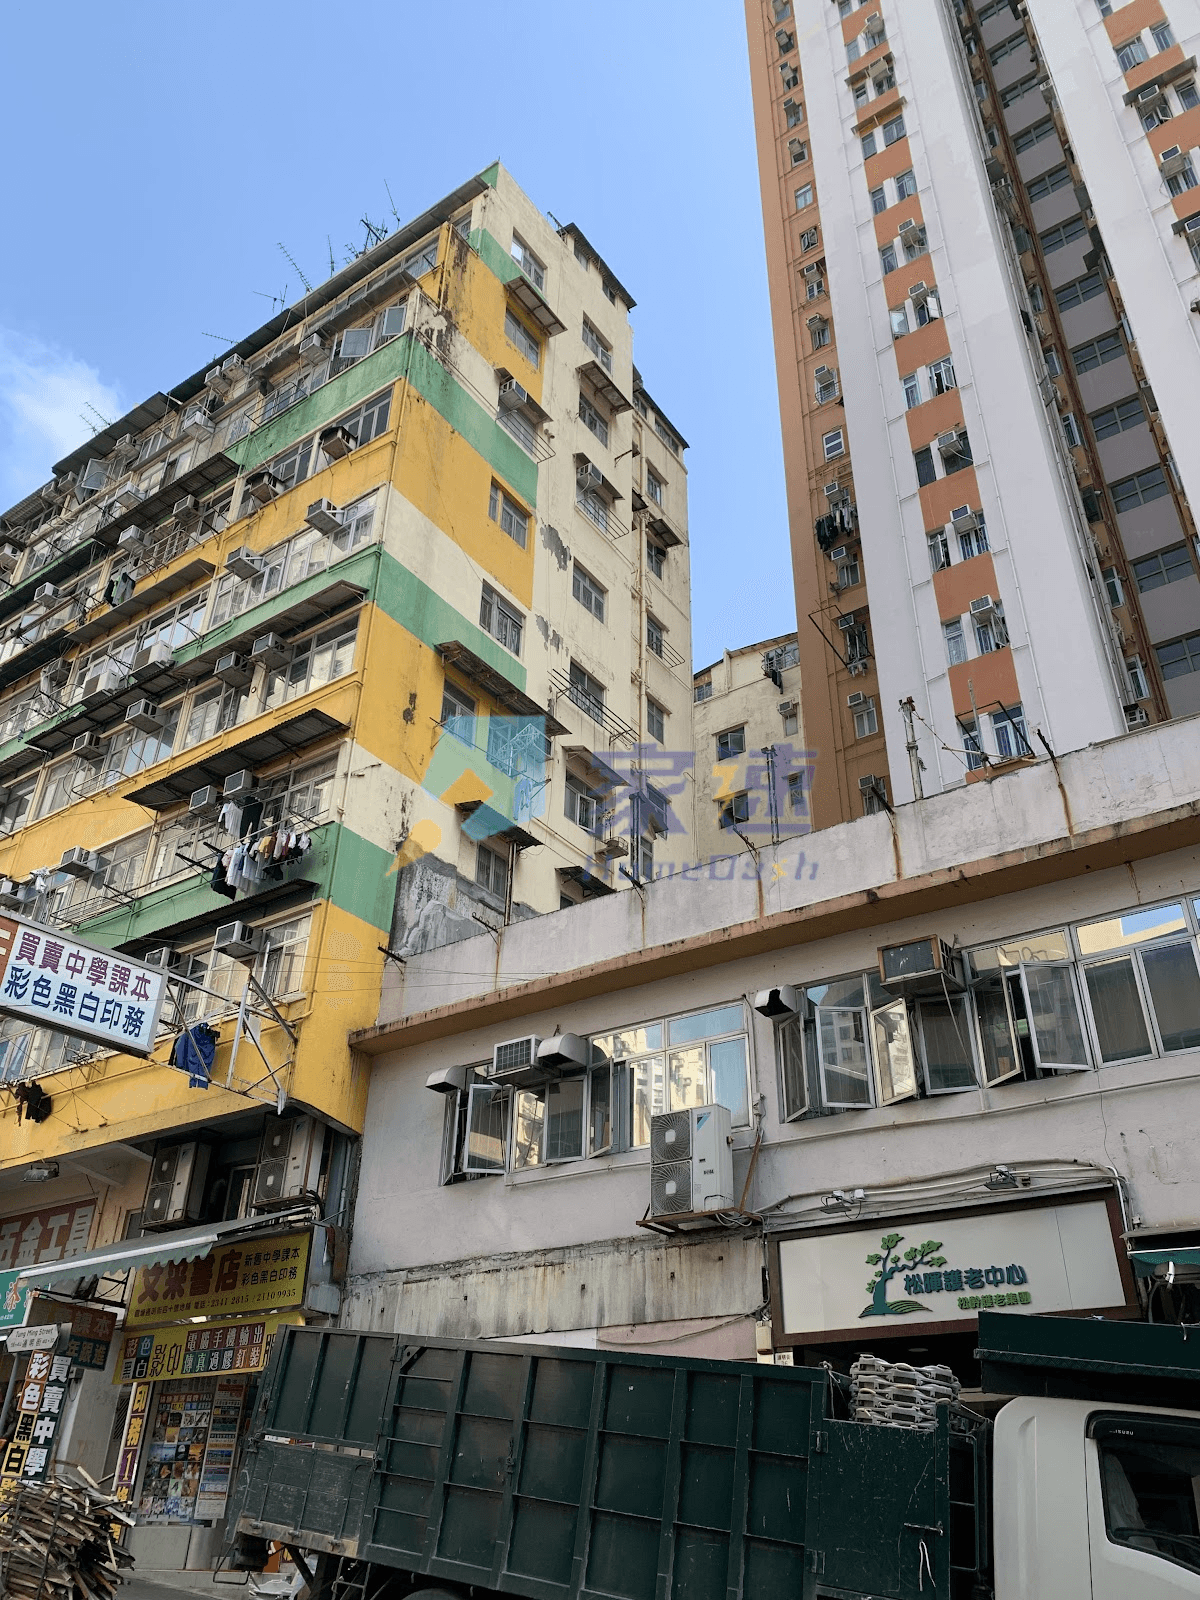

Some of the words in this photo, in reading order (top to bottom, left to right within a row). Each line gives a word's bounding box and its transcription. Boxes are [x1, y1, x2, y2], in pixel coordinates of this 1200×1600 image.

[4, 966, 146, 1038] 彩色黑白印務
[15, 931, 151, 1002] 買賣中學課本
[241, 1266, 298, 1286] 彩色黑白印務
[38, 1327, 54, 1336] Street
[24, 1355, 72, 1488] 買賣中學
